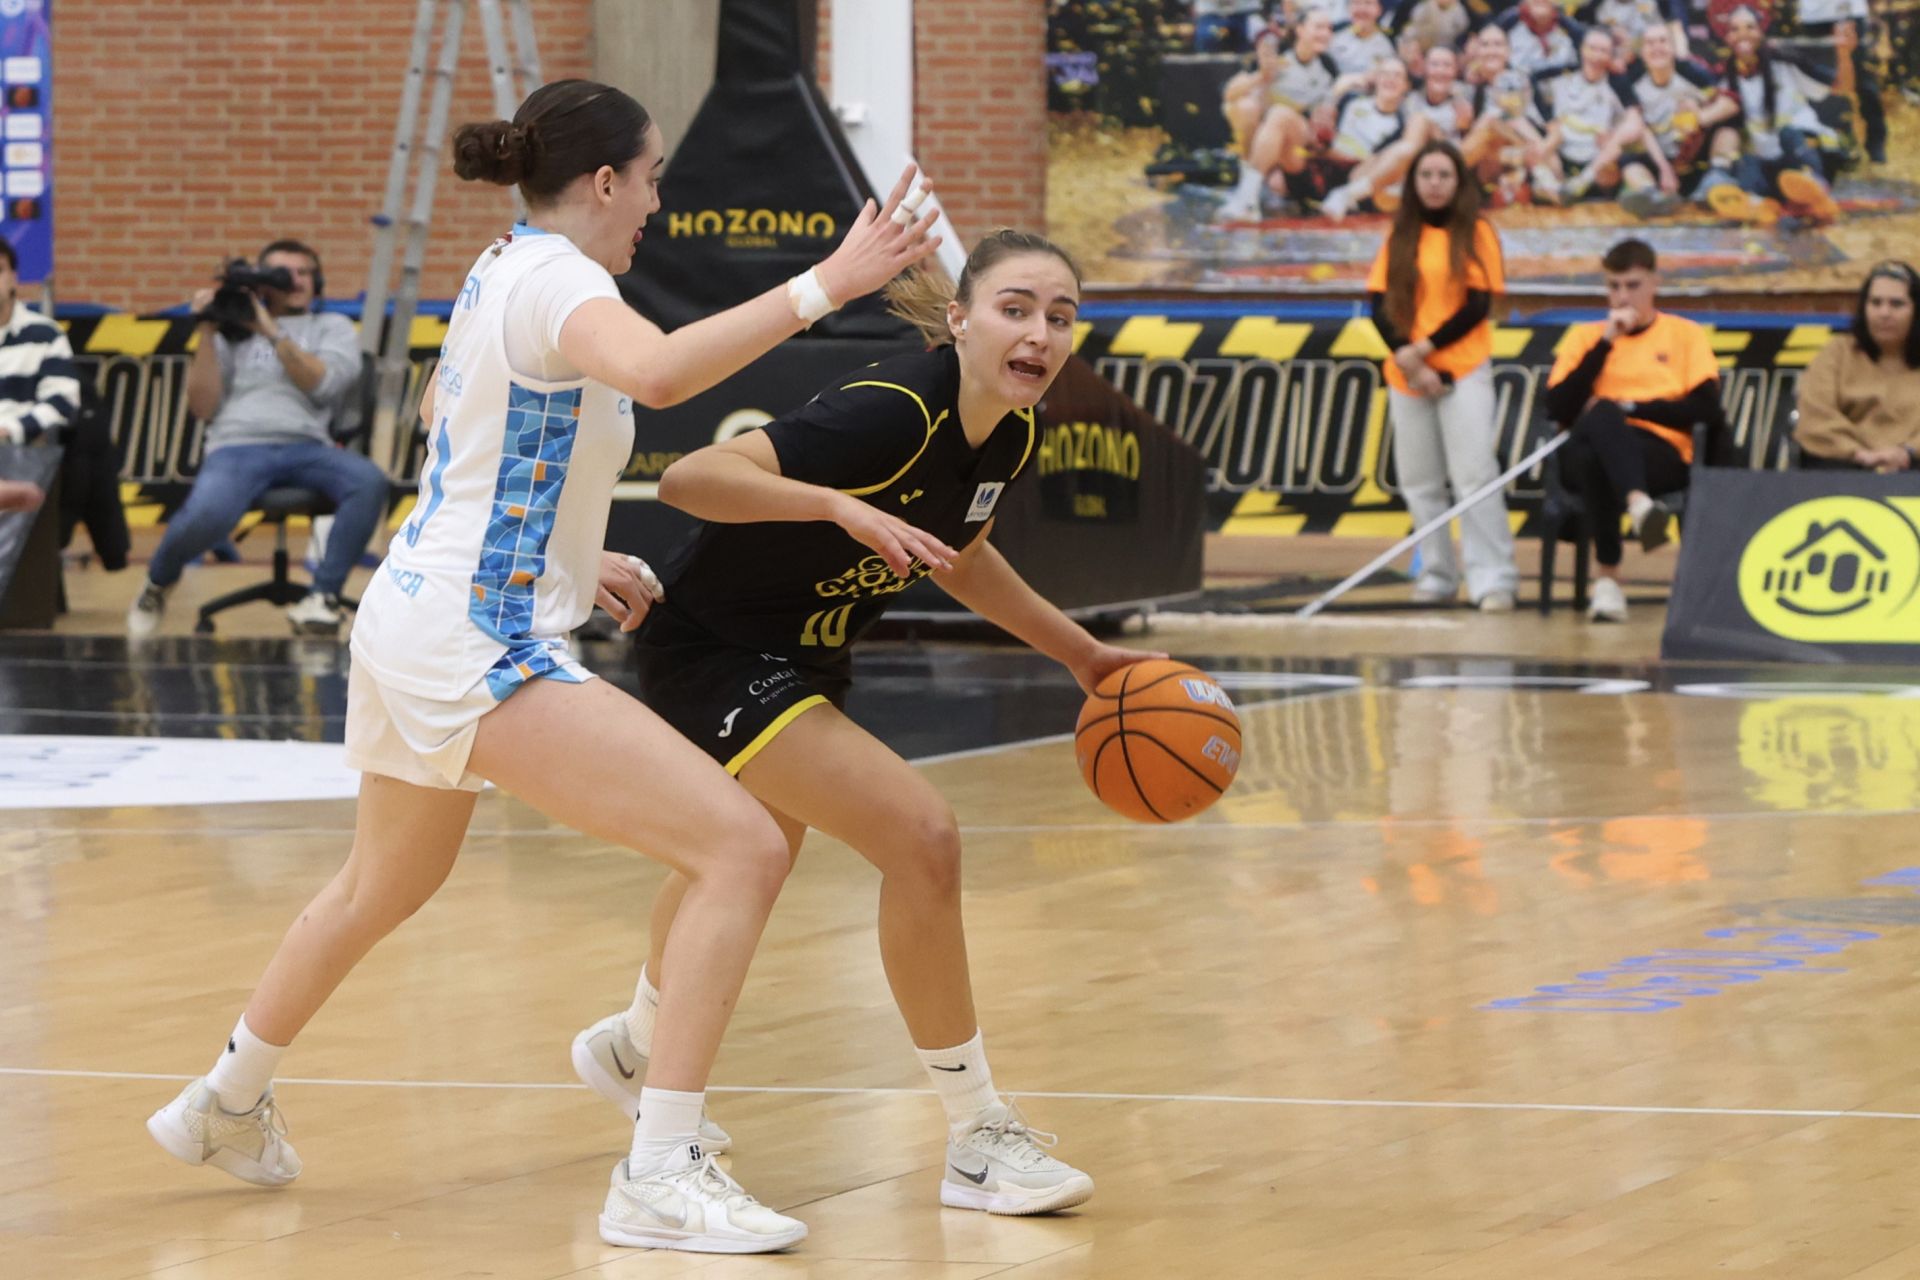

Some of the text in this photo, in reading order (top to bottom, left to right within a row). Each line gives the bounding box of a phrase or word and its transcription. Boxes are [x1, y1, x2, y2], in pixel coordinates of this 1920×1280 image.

[668, 208, 836, 240] HOZONO
[1037, 421, 1140, 481] HOZONO
[800, 602, 856, 648] 10
